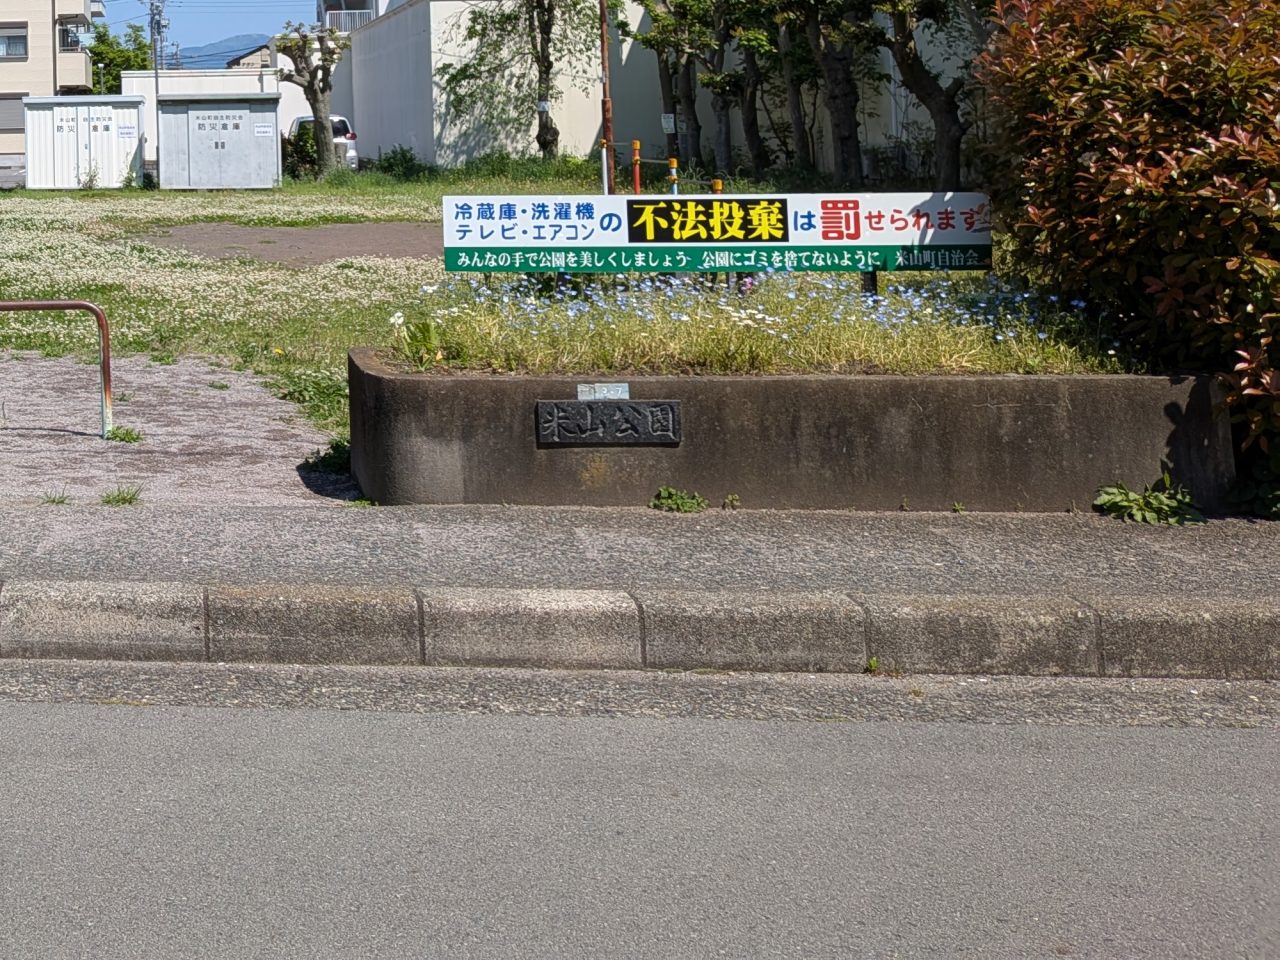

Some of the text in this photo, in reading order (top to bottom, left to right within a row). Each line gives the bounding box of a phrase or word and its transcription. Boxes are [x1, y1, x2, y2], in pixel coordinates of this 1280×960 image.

[454, 202, 595, 221] 冷蔵庫・洗濯機
[456, 222, 595, 241] テレビ・エアコン
[457, 249, 979, 268] みんなの手で公園を美しくしましょう 公園にゴミを捨てないように 米山町自治会
[541, 402, 677, 442] 米山公園
